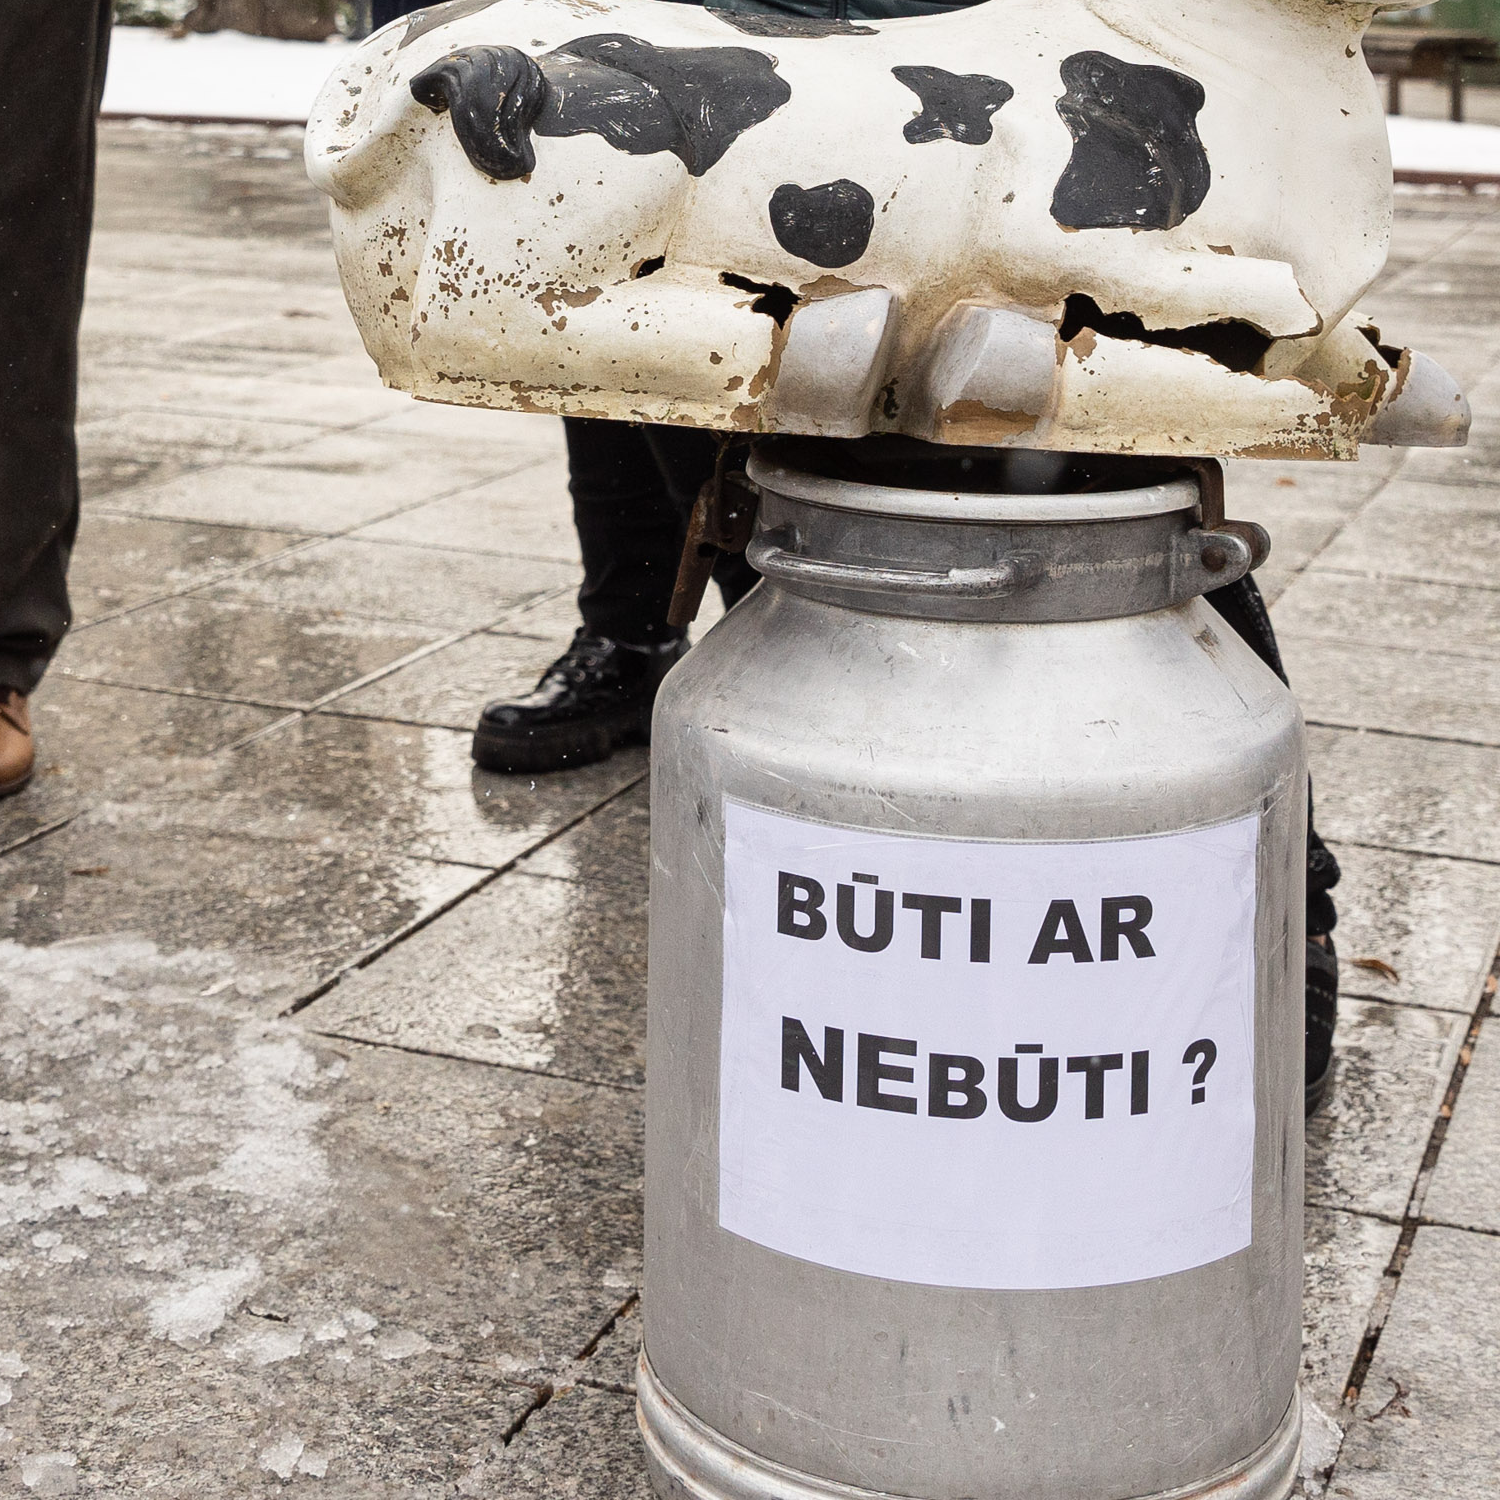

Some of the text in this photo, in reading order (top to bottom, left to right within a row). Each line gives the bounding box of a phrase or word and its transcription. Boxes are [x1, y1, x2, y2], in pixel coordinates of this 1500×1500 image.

[777, 870, 1156, 965] BŪTI AR
[781, 1015, 1218, 1123] NEBŪTI ?
